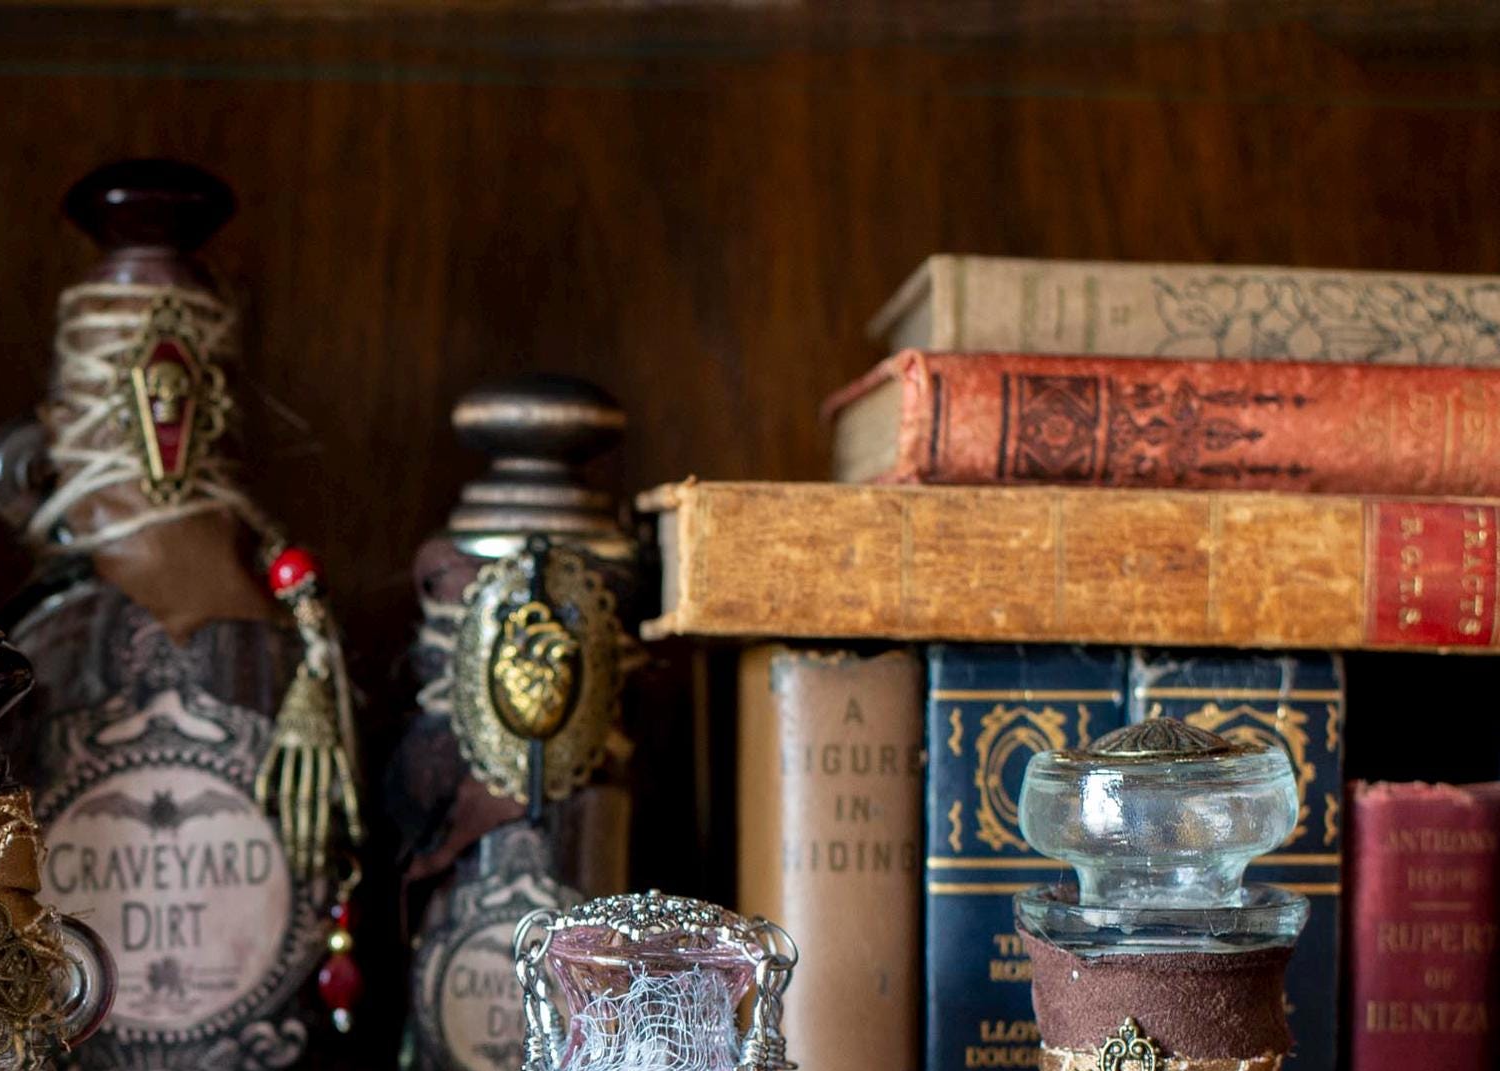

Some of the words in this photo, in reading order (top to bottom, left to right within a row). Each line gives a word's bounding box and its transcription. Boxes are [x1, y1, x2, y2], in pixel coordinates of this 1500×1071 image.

[1457, 508, 1488, 636] TRACTS
[843, 697, 864, 724] A
[835, 797, 870, 822] IN
[50, 839, 273, 895] GRAVEYARD
[121, 901, 208, 951] DIRT
